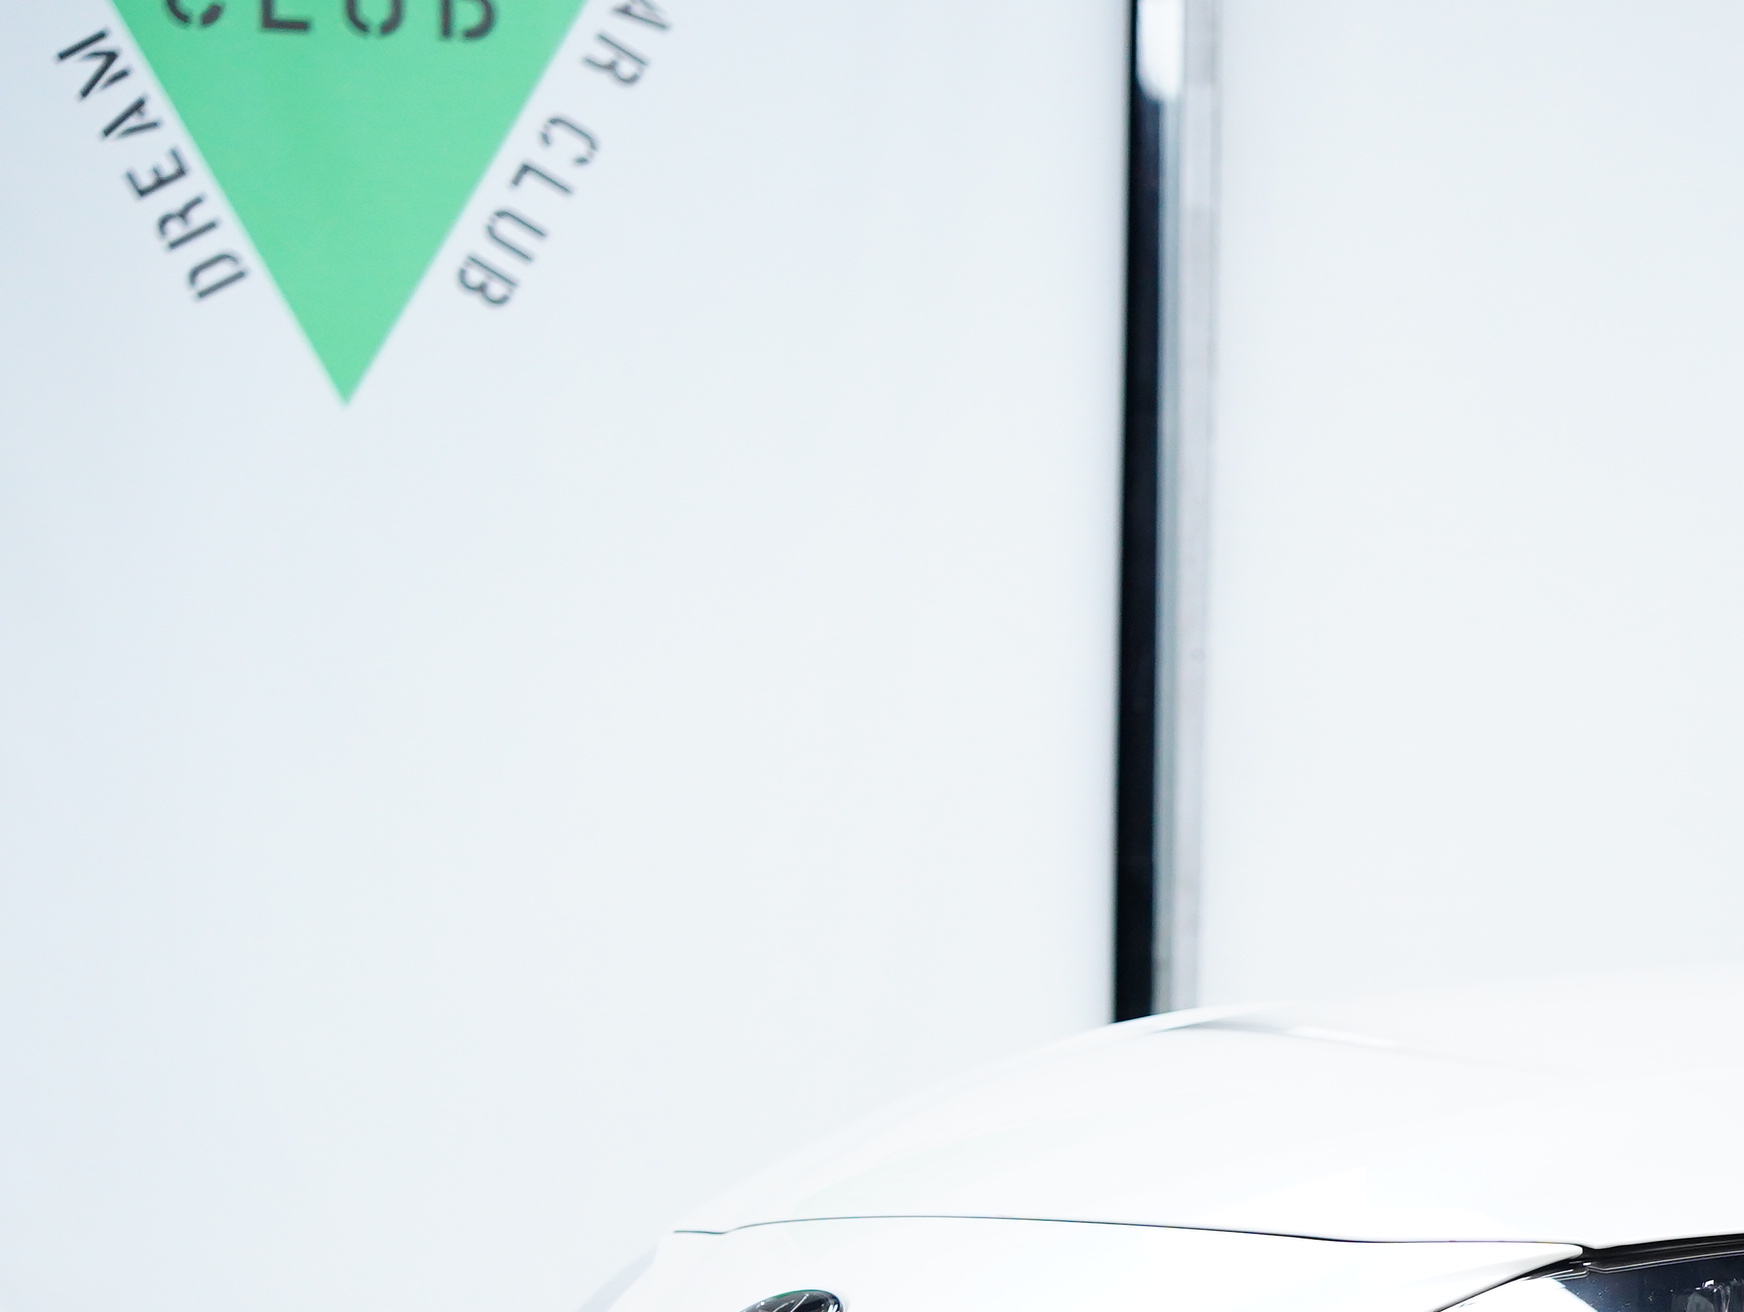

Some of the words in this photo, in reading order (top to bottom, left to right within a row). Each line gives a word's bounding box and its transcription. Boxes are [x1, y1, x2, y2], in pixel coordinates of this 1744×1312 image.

[582, 0, 671, 86] AR
[56, 29, 249, 302] DREAM
[457, 115, 600, 307] CLUB
